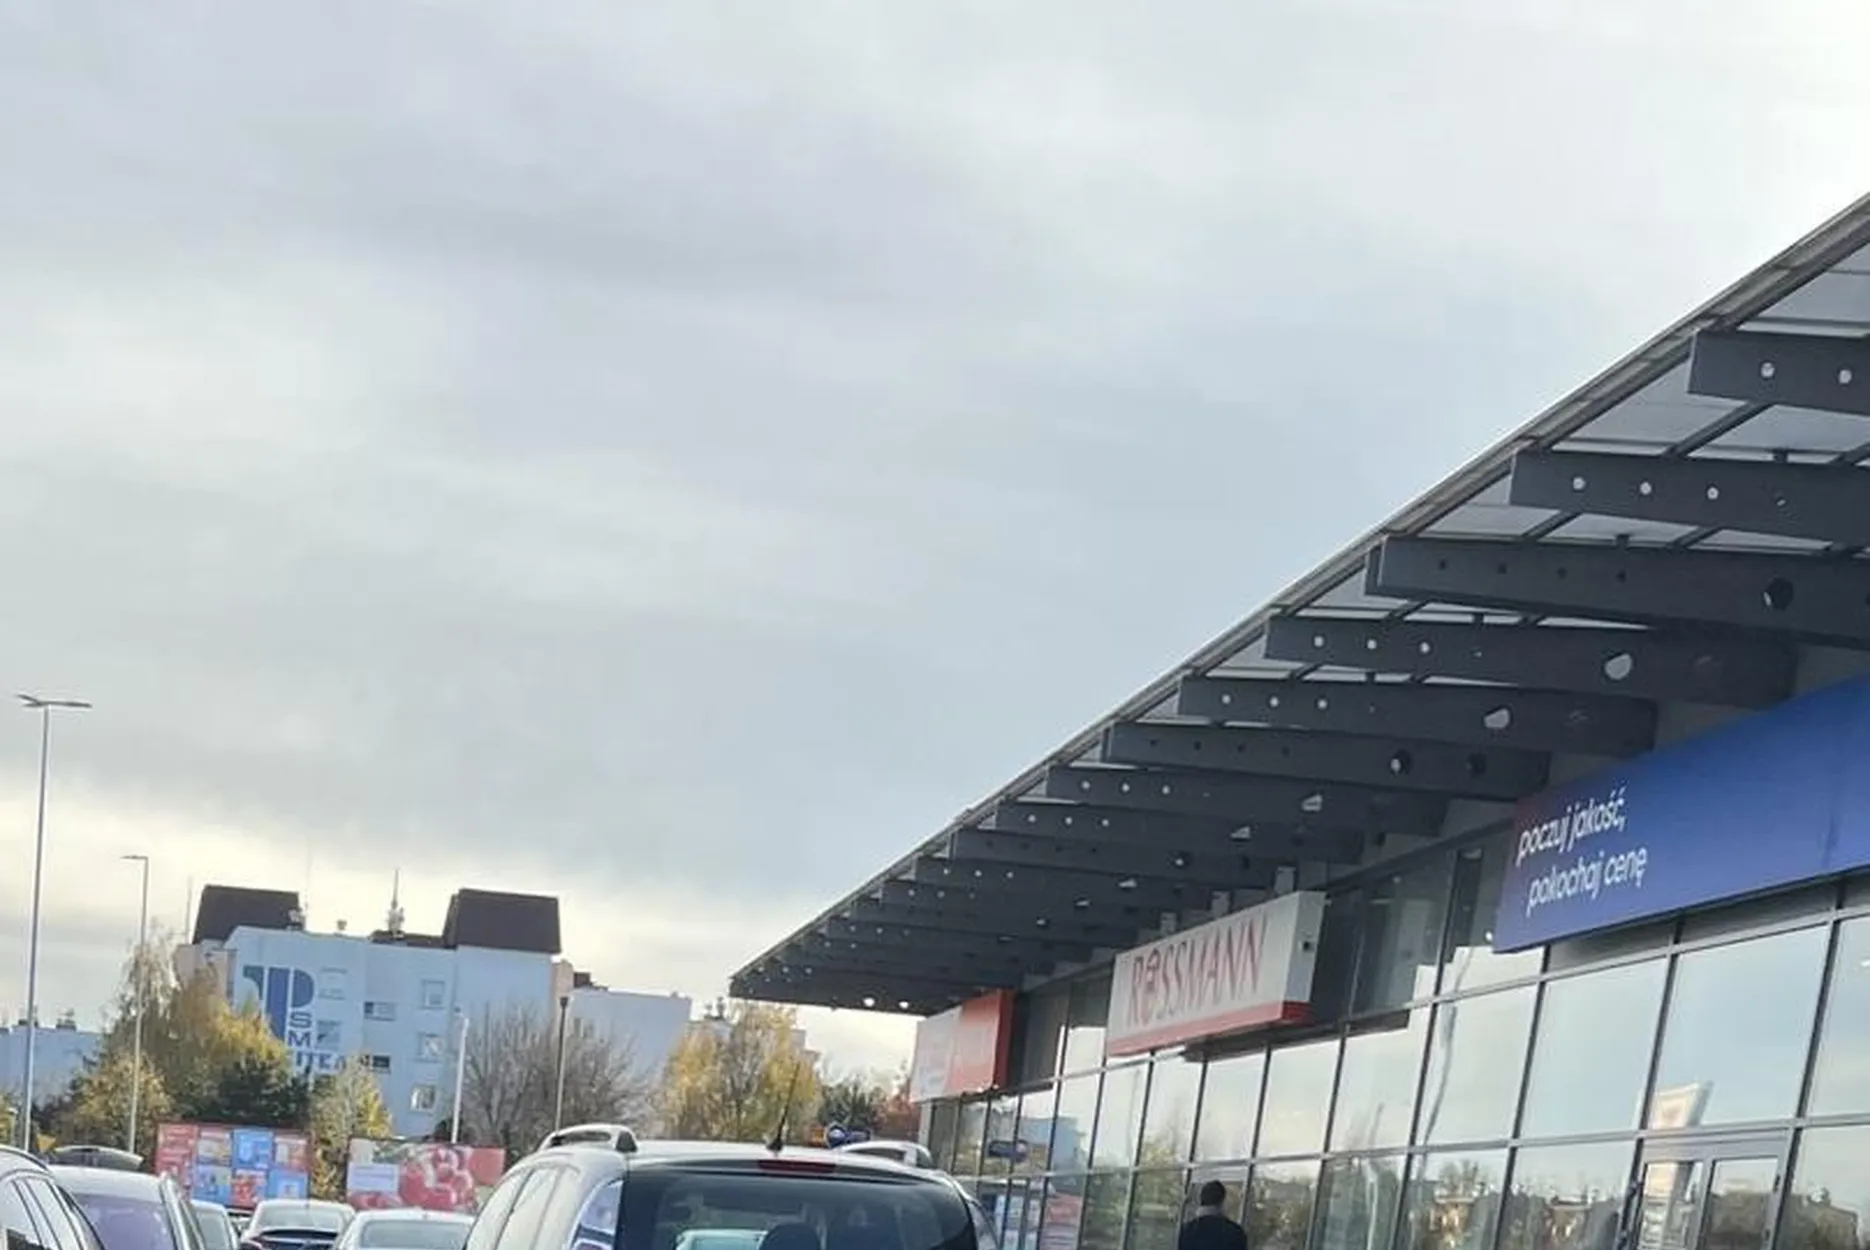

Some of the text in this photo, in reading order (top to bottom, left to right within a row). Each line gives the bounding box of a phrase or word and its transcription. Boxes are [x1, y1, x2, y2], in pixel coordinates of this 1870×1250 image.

[1515, 805, 1572, 868] poczuj
[1526, 847, 1648, 918] pokochaj cenę
[1129, 911, 1268, 1027] ROSSMANN
